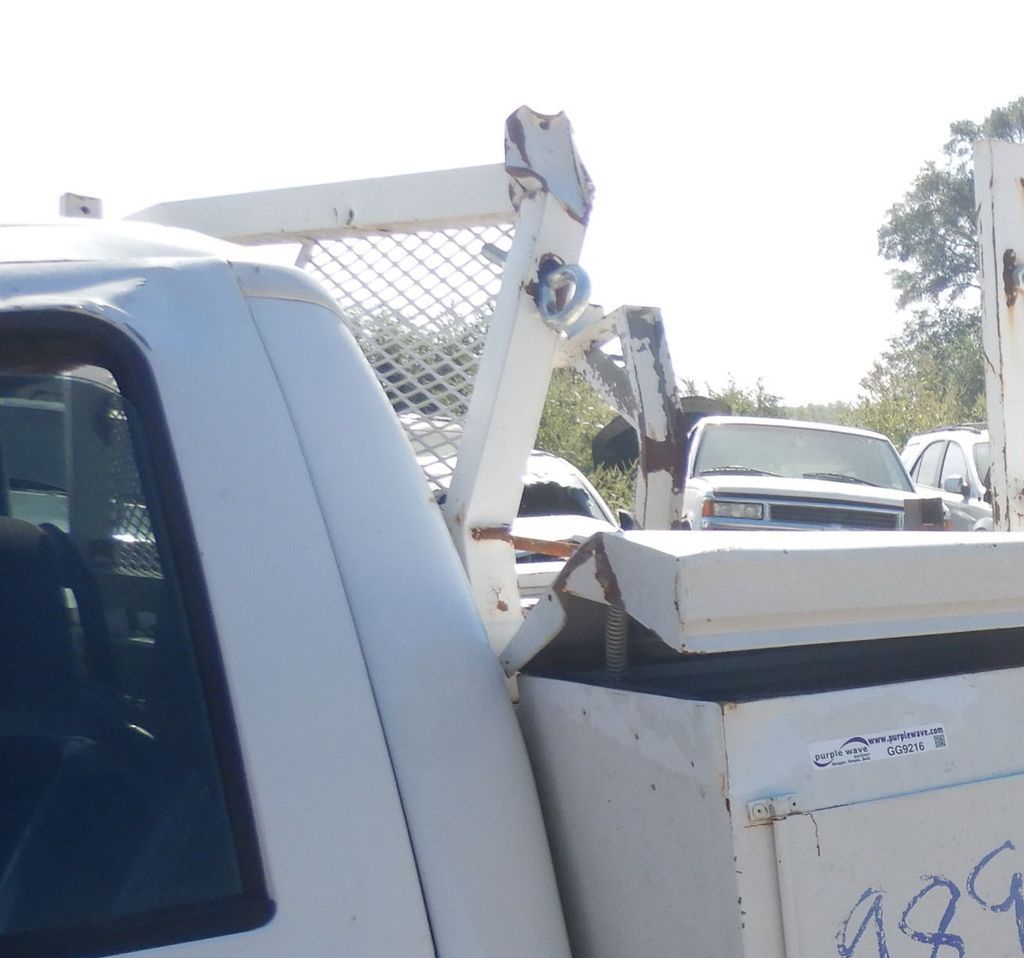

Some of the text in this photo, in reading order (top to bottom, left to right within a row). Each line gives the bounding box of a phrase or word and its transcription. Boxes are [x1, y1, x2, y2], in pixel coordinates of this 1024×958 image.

[868, 727, 944, 745] www.purplewave.com
[815, 747, 844, 761] purple
[846, 746, 868, 755] wave
[887, 742, 925, 756] GG9216
